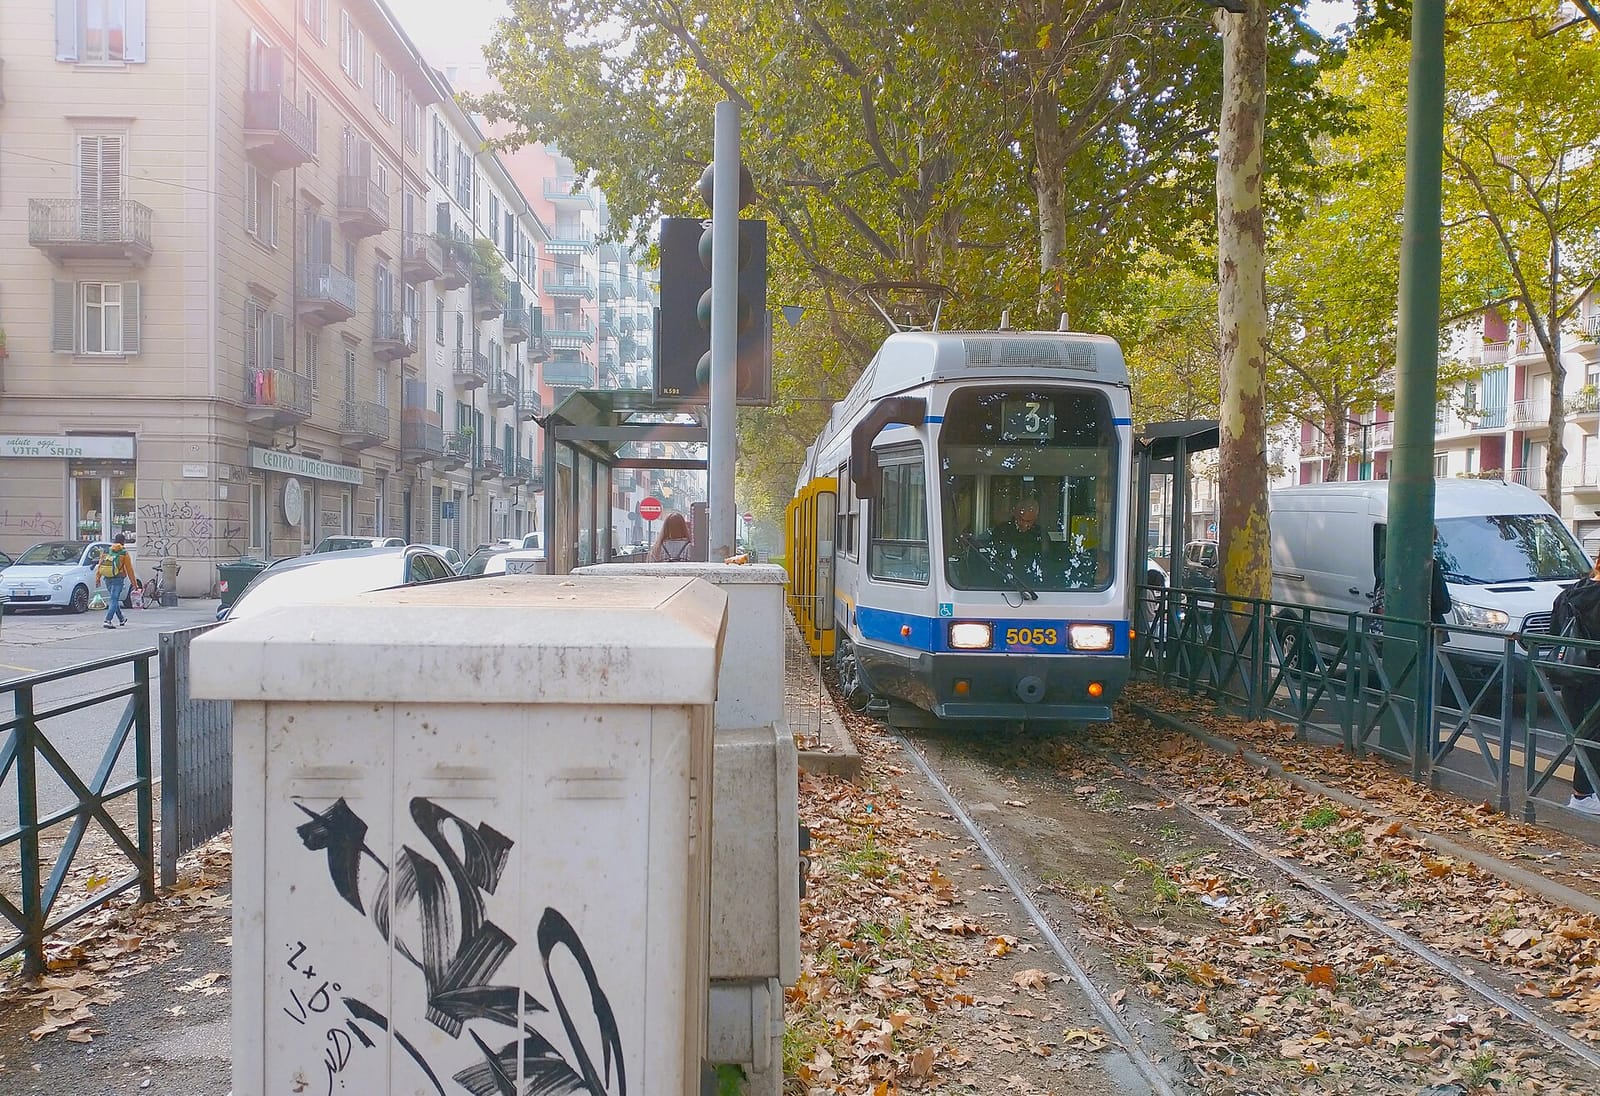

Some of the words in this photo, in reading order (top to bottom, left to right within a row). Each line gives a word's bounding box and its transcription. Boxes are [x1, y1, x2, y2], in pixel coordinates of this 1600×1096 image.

[1025, 402, 1040, 433] 3
[12, 447, 39, 456] VITA
[263, 452, 294, 470] CENTRO
[1006, 628, 1057, 645] 5053
